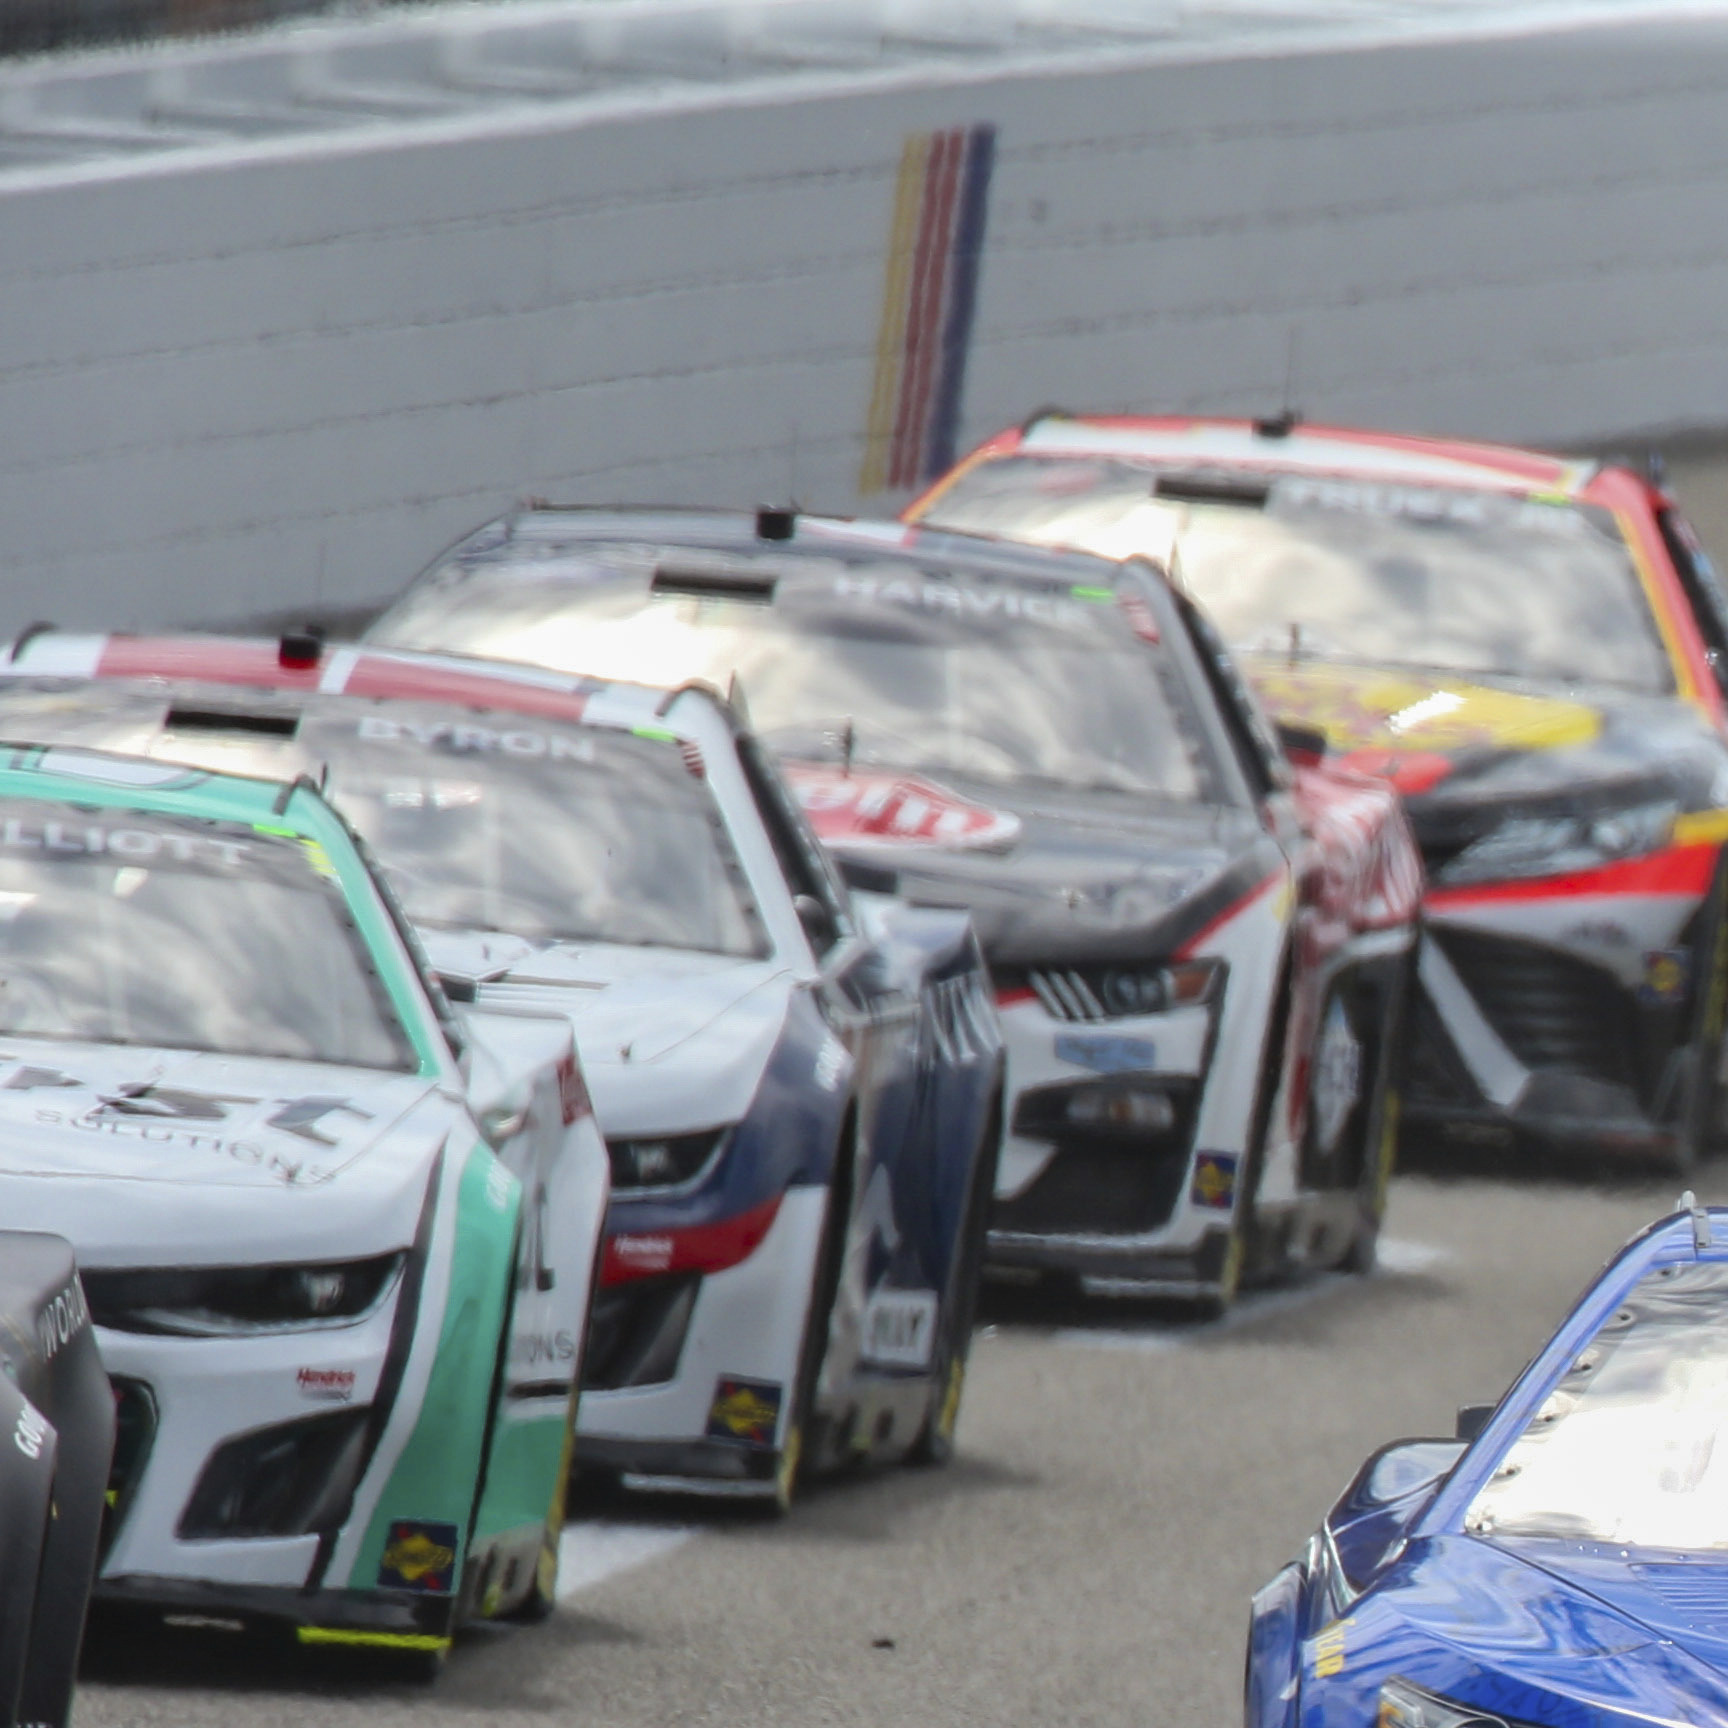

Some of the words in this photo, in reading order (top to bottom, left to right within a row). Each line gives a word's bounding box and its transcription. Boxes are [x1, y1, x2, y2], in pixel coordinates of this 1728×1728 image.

[832, 576, 1092, 628] HARVICK
[356, 716, 597, 762] BYRON
[0, 818, 250, 866] LLIOTT
